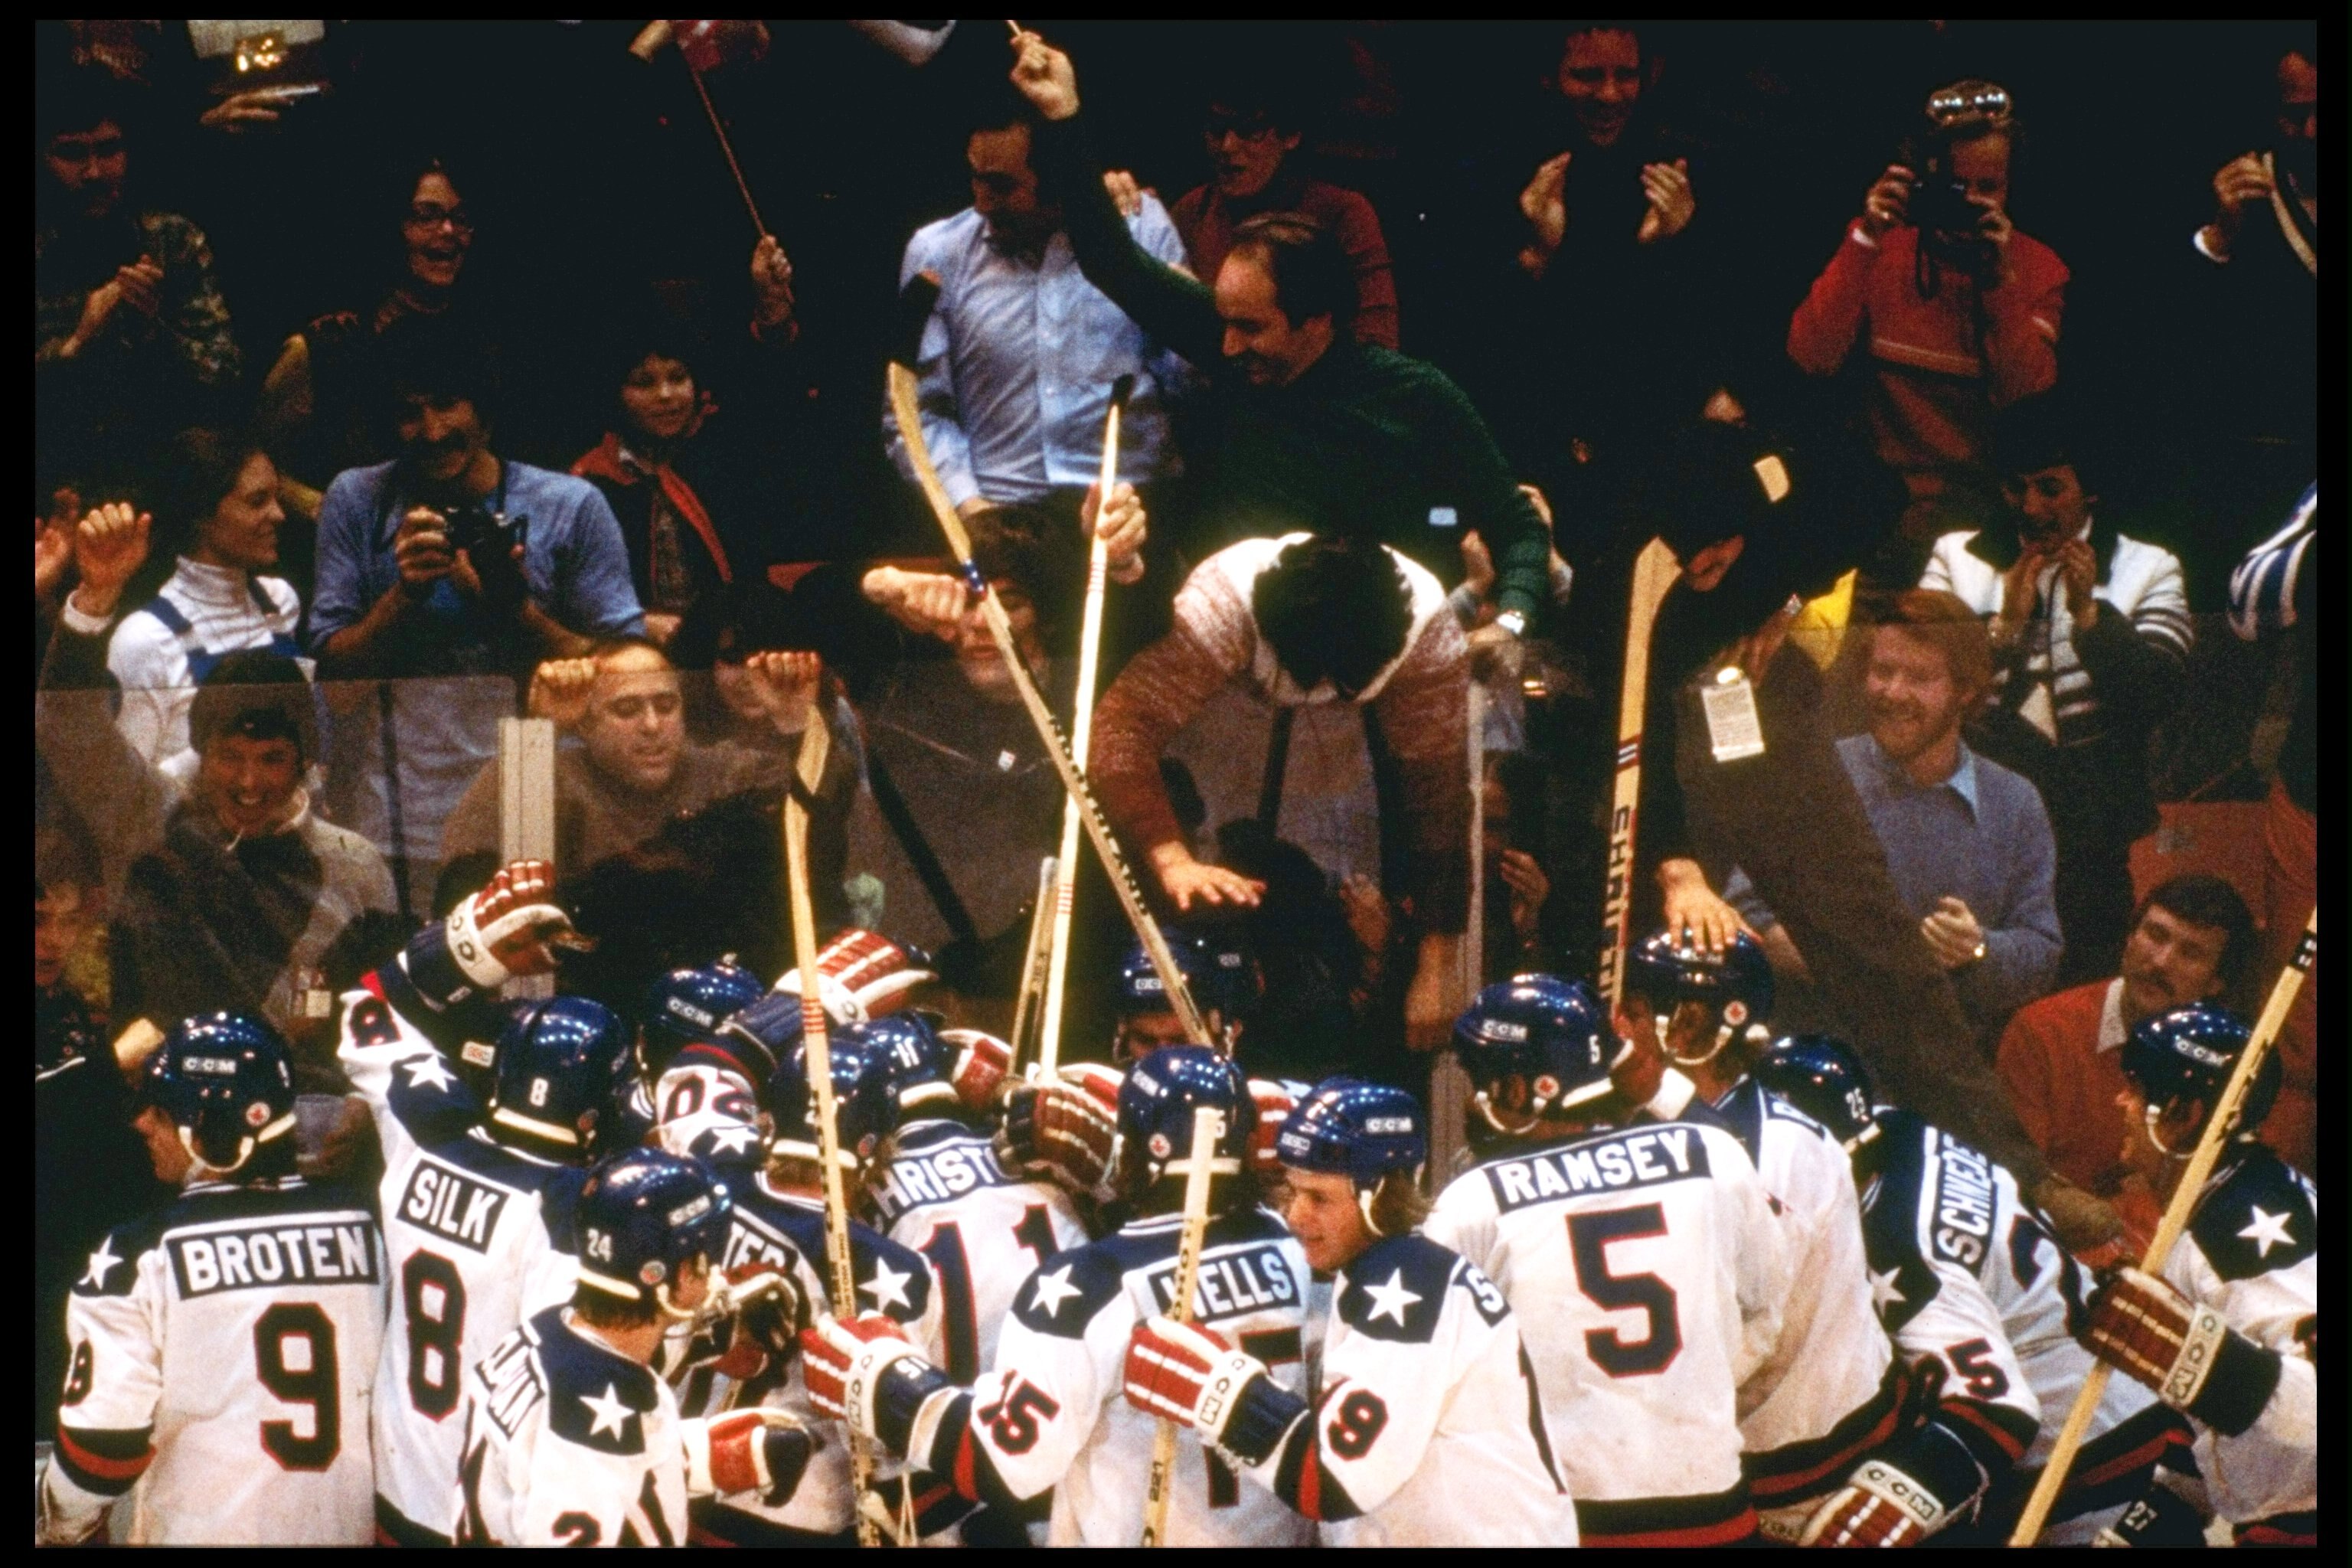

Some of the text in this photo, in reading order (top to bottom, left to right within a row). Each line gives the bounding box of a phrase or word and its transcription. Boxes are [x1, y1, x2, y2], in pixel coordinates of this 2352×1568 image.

[1482, 1020, 1527, 1042] CCM
[183, 1057, 237, 1074] CCM
[531, 1078, 548, 1107] 8
[1365, 1117, 1413, 1133] CCM
[1497, 1129, 1690, 1205] RAMSEY
[407, 1168, 499, 1244] SILK
[181, 1227, 370, 1292] BROTEN
[587, 1228, 611, 1263] 24
[1566, 1201, 1684, 1378] 5
[403, 1248, 466, 1423] 8
[254, 1302, 340, 1472] 9
[1866, 1466, 1936, 1522] CCM
